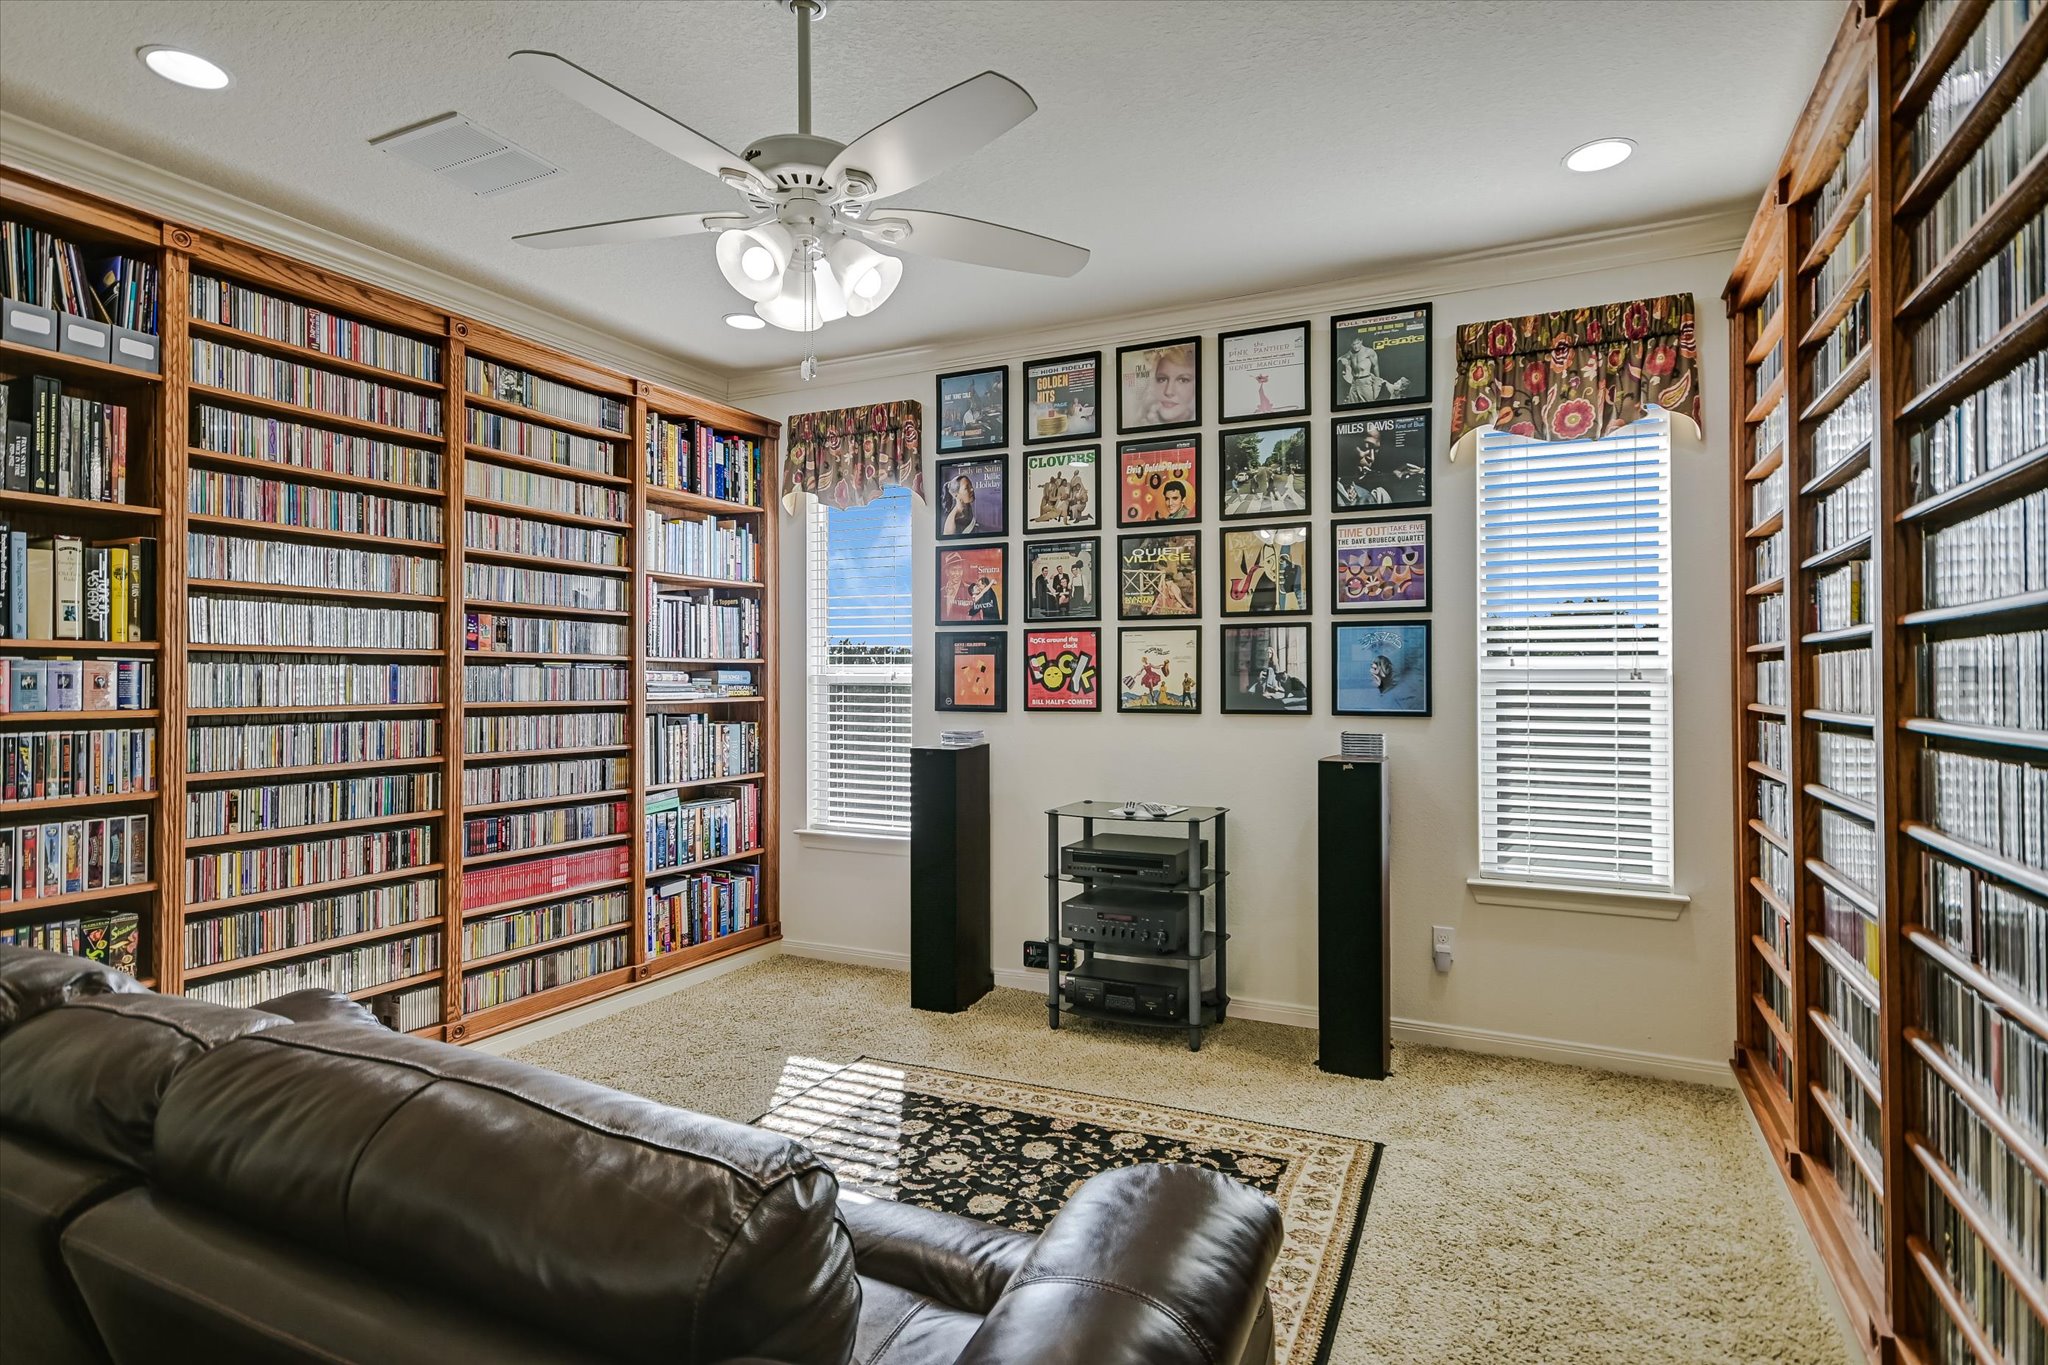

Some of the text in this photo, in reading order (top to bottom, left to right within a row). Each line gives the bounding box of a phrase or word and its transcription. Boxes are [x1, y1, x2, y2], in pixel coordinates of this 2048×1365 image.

[1373, 335, 1424, 350] picnic
[1254, 344, 1290, 353] PANTHER
[1062, 362, 1094, 371] FIDELITY
[1256, 359, 1290, 367] MANCINI
[1037, 374, 1068, 391] GOLDEN
[1037, 390, 1056, 404] HITS
[1336, 420, 1394, 435] MILES DAVIS
[1028, 452, 1095, 469] CLOVERS
[976, 480, 1000, 488] Holiday
[1338, 528, 1363, 538] TIME
[1366, 526, 1386, 536] OUT
[1398, 534, 1424, 542] QUARTET
[1132, 547, 1183, 556] QUIET
[1123, 553, 1191, 564] VILLAGE
[87, 570, 99, 622] YESTERDAY
